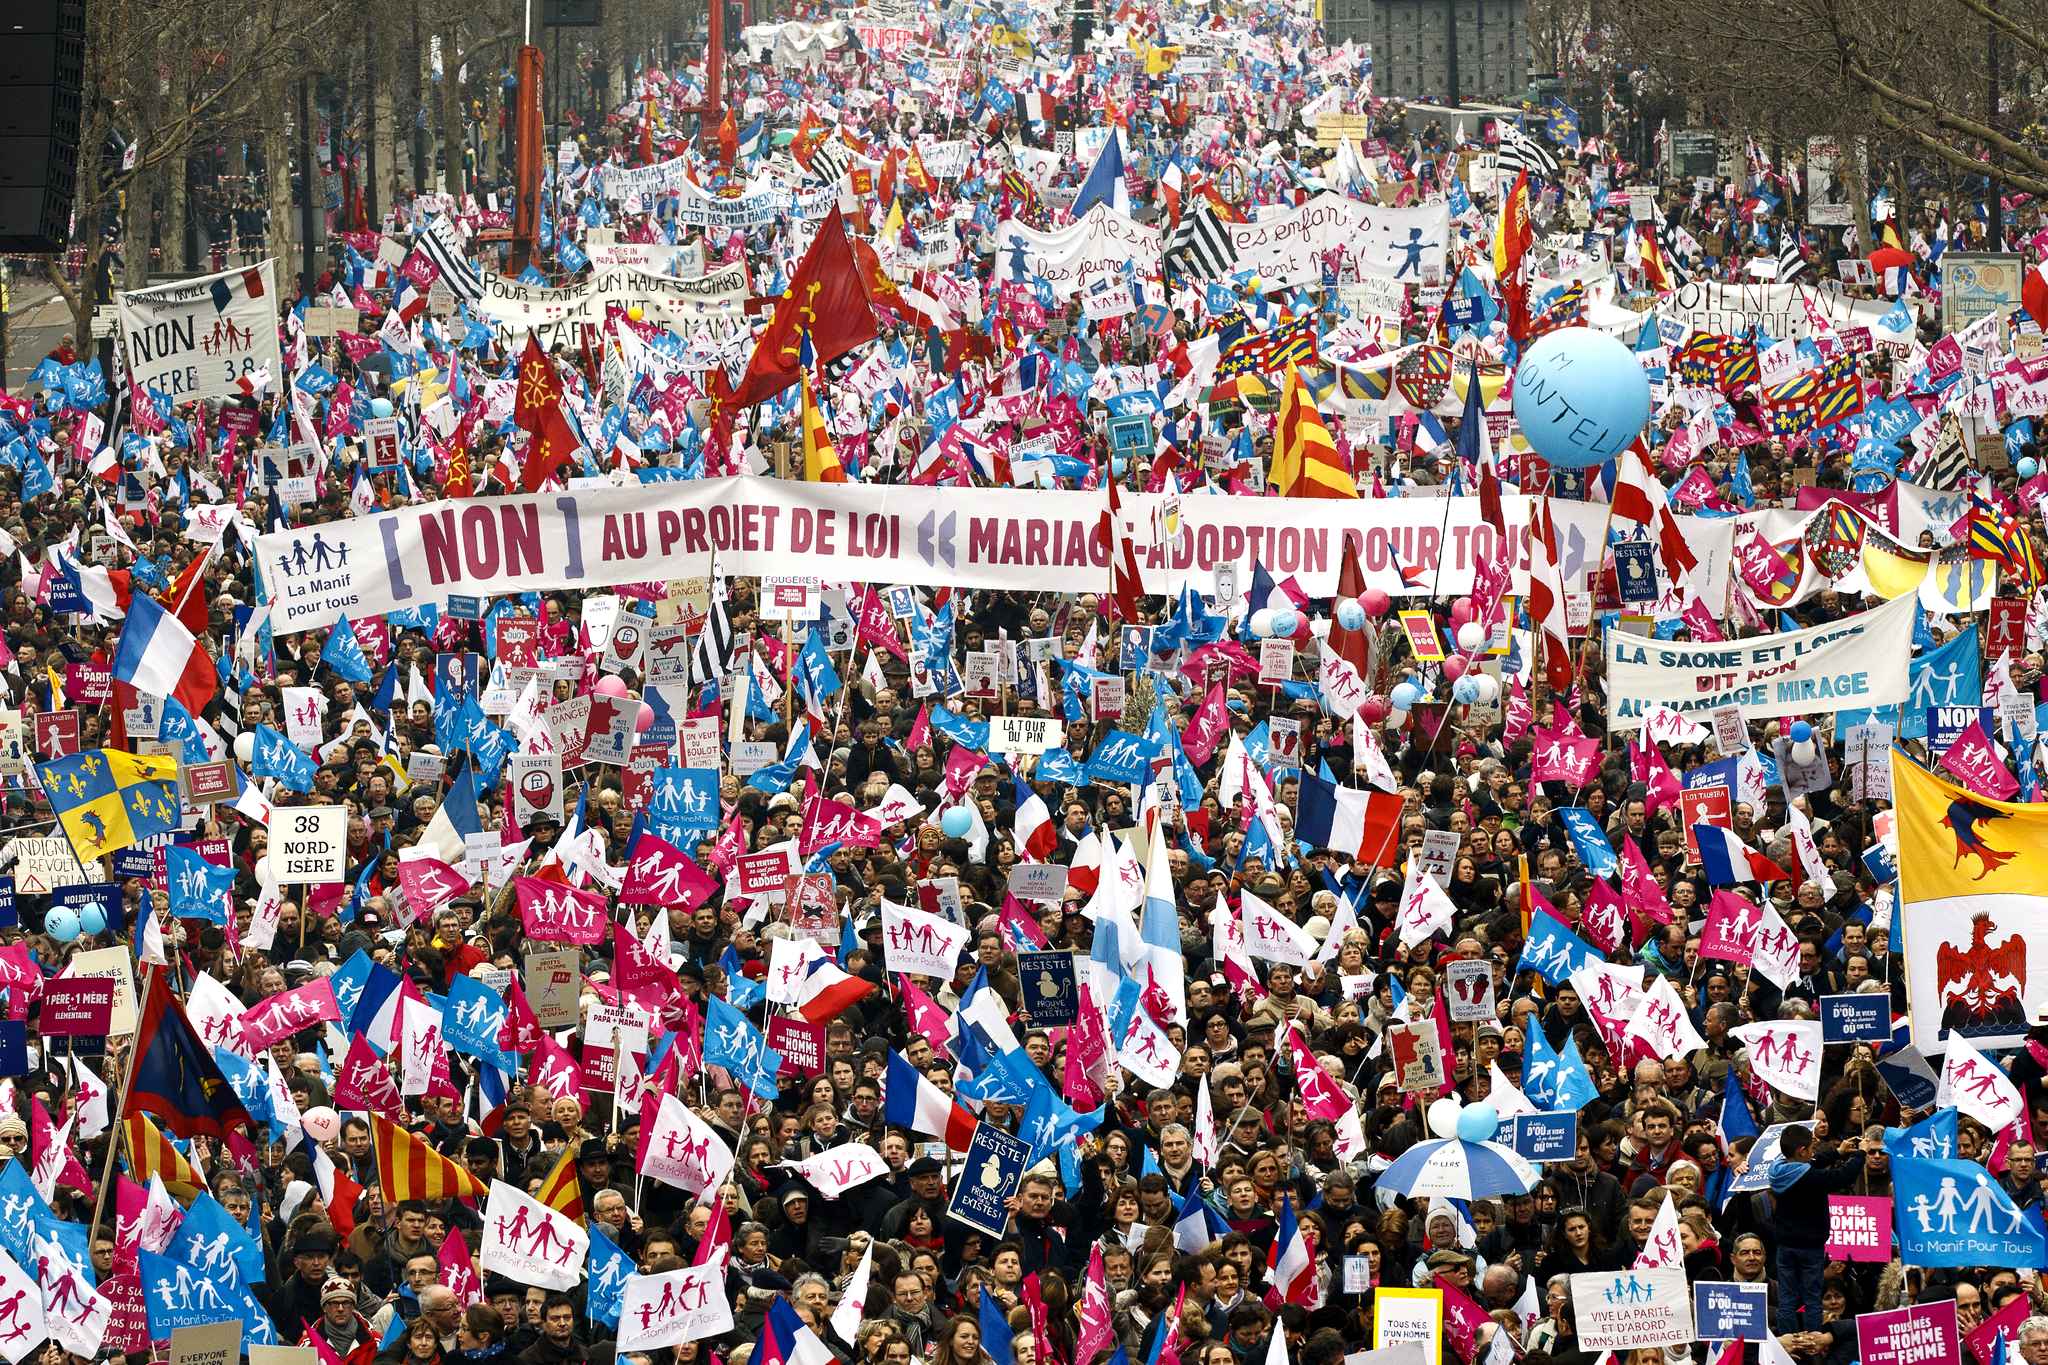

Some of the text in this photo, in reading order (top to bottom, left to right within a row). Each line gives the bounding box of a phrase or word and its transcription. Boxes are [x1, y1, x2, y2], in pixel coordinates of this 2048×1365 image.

[688, 198, 701, 209] LE
[681, 211, 746, 224] C'EST PAS POUR
[485, 272, 746, 301] POUR FAIRE UN HAUT SAVOYARD
[1452, 299, 1472, 311] NON
[130, 313, 194, 369] NON
[1549, 352, 1574, 372] M
[224, 356, 252, 383] 38
[1735, 522, 1756, 536] PAS
[419, 504, 544, 585] NON
[602, 512, 647, 560] AU
[658, 504, 780, 556] PROJET
[790, 506, 836, 556] DE
[848, 512, 900, 559] LOI
[968, 516, 1328, 573] MARIAG-ADOPTION
[1341, 524, 1440, 573] POUR
[287, 574, 352, 598] La Manif
[671, 586, 703, 597] DANGER
[53, 592, 67, 600] PAS
[287, 593, 359, 620] pour tous
[1616, 644, 1648, 665] LA
[1753, 644, 1783, 666] ET
[1696, 659, 1797, 693] DIT NON
[1617, 697, 1652, 718] AU
[1777, 672, 1869, 704] MIRAGE
[551, 709, 589, 727] DANGER
[1938, 708, 1980, 728] NON
[1003, 720, 1046, 732] LA TOUR
[686, 731, 702, 742] ON
[704, 730, 718, 740] VEUT
[1008, 732, 1043, 743] DU PIN
[687, 746, 718, 757] BOULOT
[1686, 790, 1725, 801] LOI TAUBIRA
[294, 816, 320, 833] 38
[203, 844, 225, 854] MÈRE
[284, 842, 337, 854] NORD-
[286, 857, 335, 874] ISÈRE
[757, 858, 781, 867] VENTRES
[749, 875, 787, 889] CADDIES
[542, 925, 565, 935] Manif
[585, 930, 600, 939] Tous
[1707, 943, 1718, 951] La
[106, 966, 122, 977] NÉS
[51, 991, 108, 1005] PÈRE 1 MÈRE
[1036, 999, 1065, 1008] PROUVE
[55, 1009, 92, 1020] ÉLÉMENTAIRE
[604, 1008, 635, 1019] MADE IN
[1833, 1005, 1856, 1018] D'OÙ
[593, 1013, 644, 1030] PAPA MAMAN
[1842, 1023, 1857, 1034] OÙ
[443, 1025, 458, 1035] La
[785, 1027, 813, 1041] TOUS NÉS
[786, 1040, 818, 1057] HOMME
[788, 1055, 819, 1070] FEMME
[1527, 1124, 1546, 1137] D'OÙ
[1533, 1140, 1546, 1153] OÙ
[972, 1186, 999, 1205] PROUVE
[962, 1195, 1002, 1219] EXISTES!
[1847, 1204, 1866, 1216] NÉS
[1830, 1216, 1877, 1231] OMME
[1906, 1239, 2034, 1254] La Manif Pour Tous
[107, 1281, 144, 1298] Je su
[1708, 1296, 1731, 1310] D'OÙ
[155, 1315, 200, 1327] La Manif
[1591, 1306, 1675, 1322] VIVE LA PARITÉ,
[105, 1318, 146, 1333] pas un
[1388, 1319, 1410, 1329] TOUS
[1602, 1320, 1667, 1334] ET D'ABORD
[1718, 1316, 1733, 1331] OÙ
[1888, 1317, 1932, 1335] TOUS NÉS
[101, 1333, 133, 1348] droit
[1383, 1330, 1431, 1339] D'UN HOMME
[1584, 1329, 1683, 1348] DANS LE MARIAGE
[1874, 1326, 1944, 1351] D'UN HOMME
[181, 1350, 228, 1363] EVERYONE
[1869, 1343, 1948, 1365] ET D'UNE FEMME
